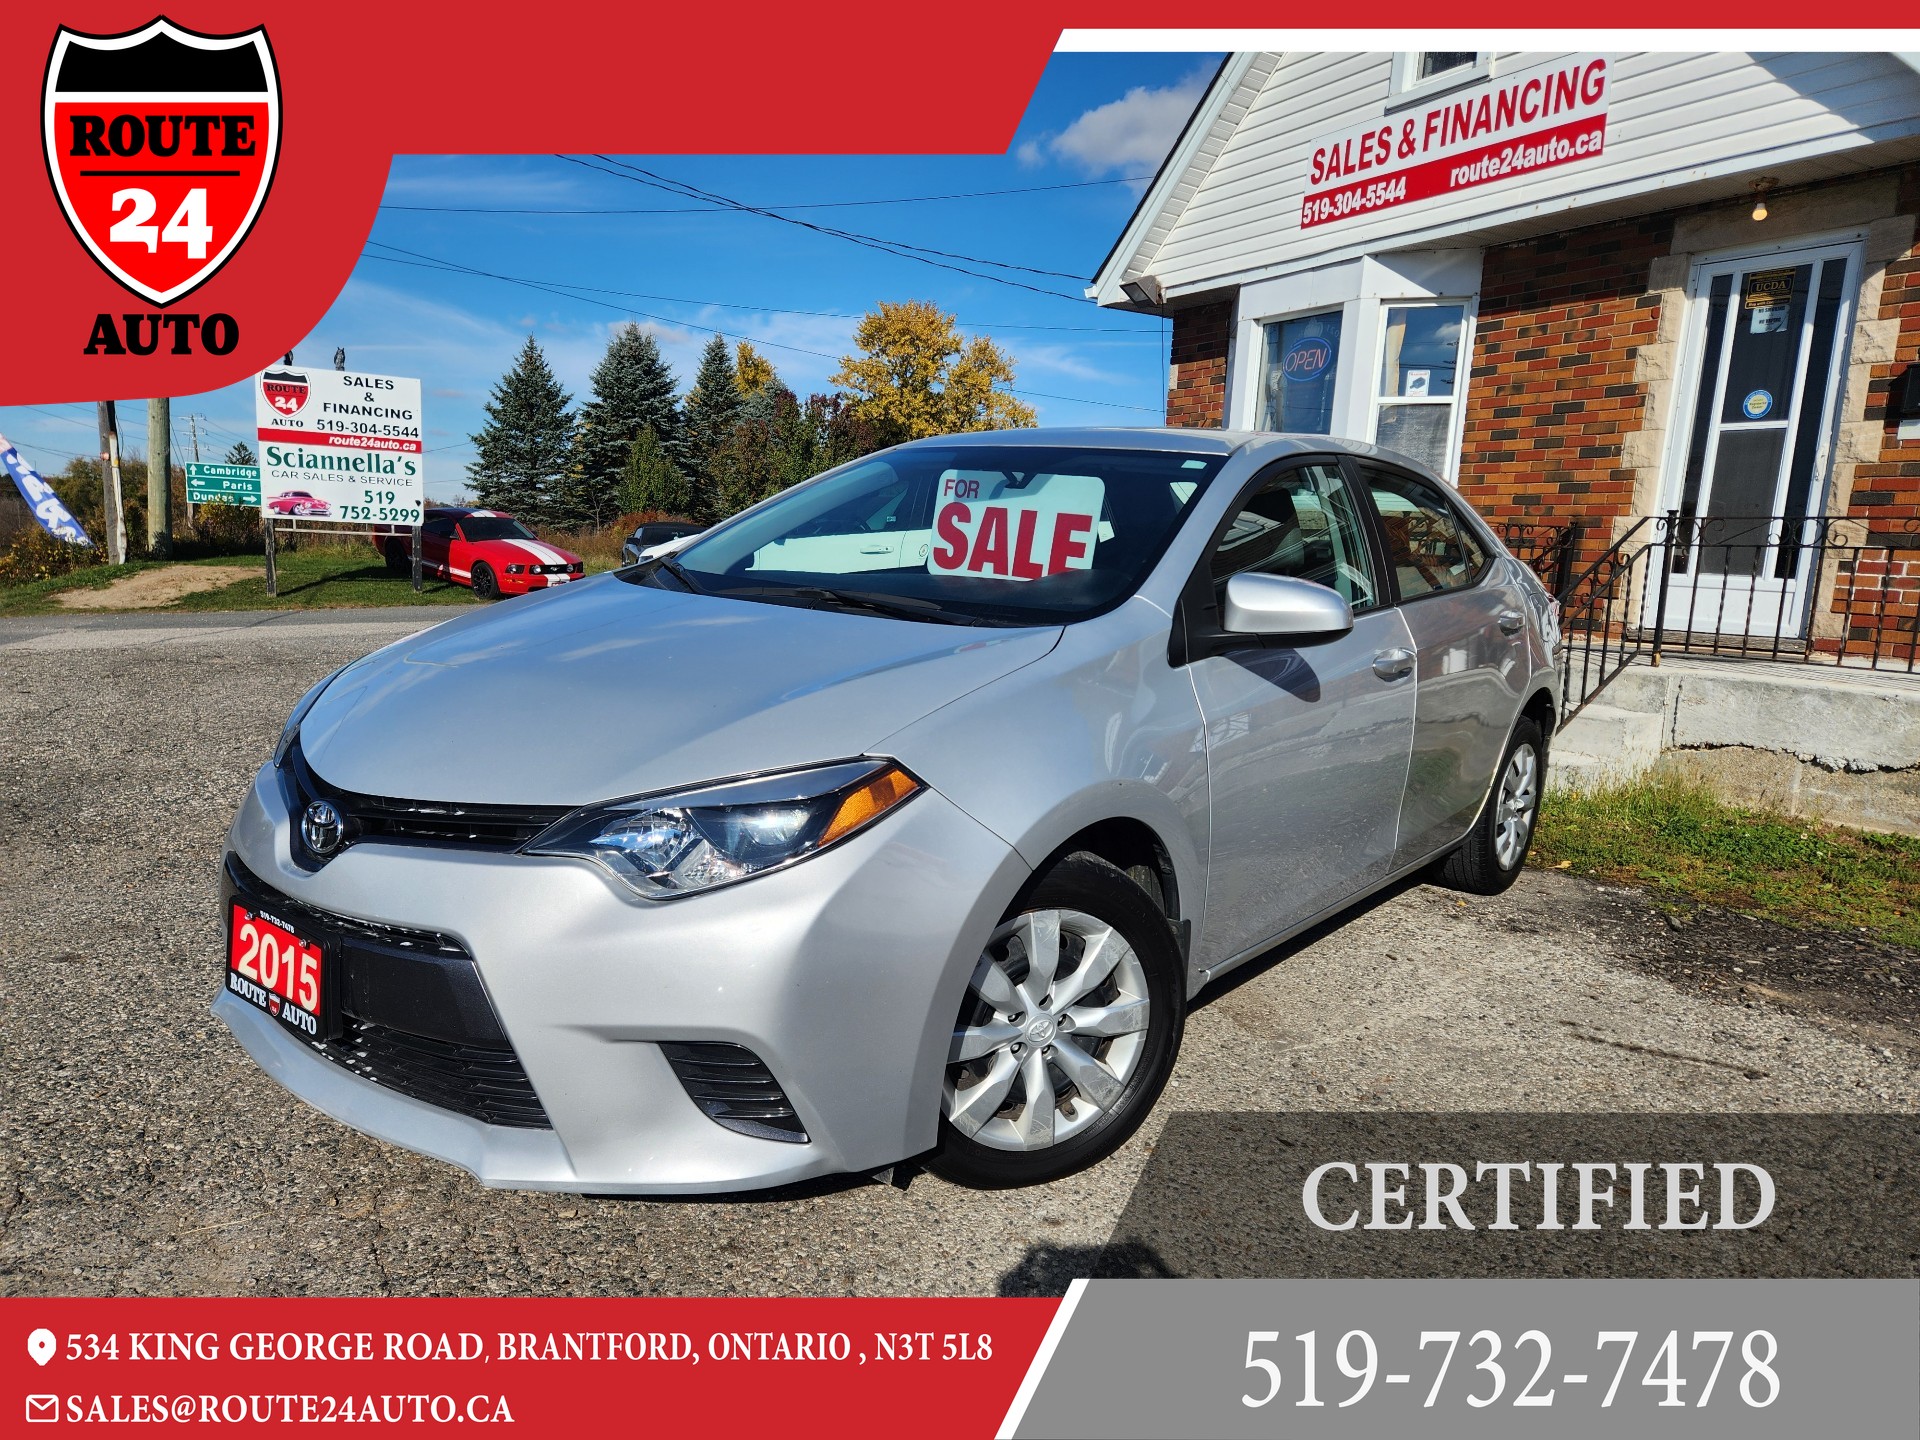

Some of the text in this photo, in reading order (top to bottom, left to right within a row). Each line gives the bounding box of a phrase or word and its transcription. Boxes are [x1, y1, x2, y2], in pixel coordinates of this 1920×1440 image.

[1310, 58, 1606, 186] SALES & FINANCING
[1302, 129, 1603, 225] 519-304-5544 route24auto.ca
[1755, 280, 1787, 292] UCDA
[1285, 347, 1328, 372] OPEN
[266, 384, 307, 395] ROUTE
[343, 375, 395, 391] SALES
[274, 396, 299, 412] 24
[363, 391, 375, 403] &
[323, 402, 413, 421] FINANCING
[271, 418, 304, 428] AUTO
[316, 418, 419, 438] 519-304-5544
[328, 436, 417, 451] route24auto.ca
[266, 446, 417, 476] Sciannella's
[203, 465, 257, 478] Cambridge
[271, 469, 413, 487] CAR SALES & SERVICE
[222, 480, 253, 491] Paris
[943, 478, 980, 499] FOR
[193, 491, 235, 503] Dundas
[364, 490, 396, 505] 519
[339, 505, 420, 523] 752-5299
[932, 501, 1093, 581] SALE
[237, 922, 318, 1013] 2015
[229, 972, 267, 1008] ROUTE
[281, 1002, 317, 1036] AUTO
